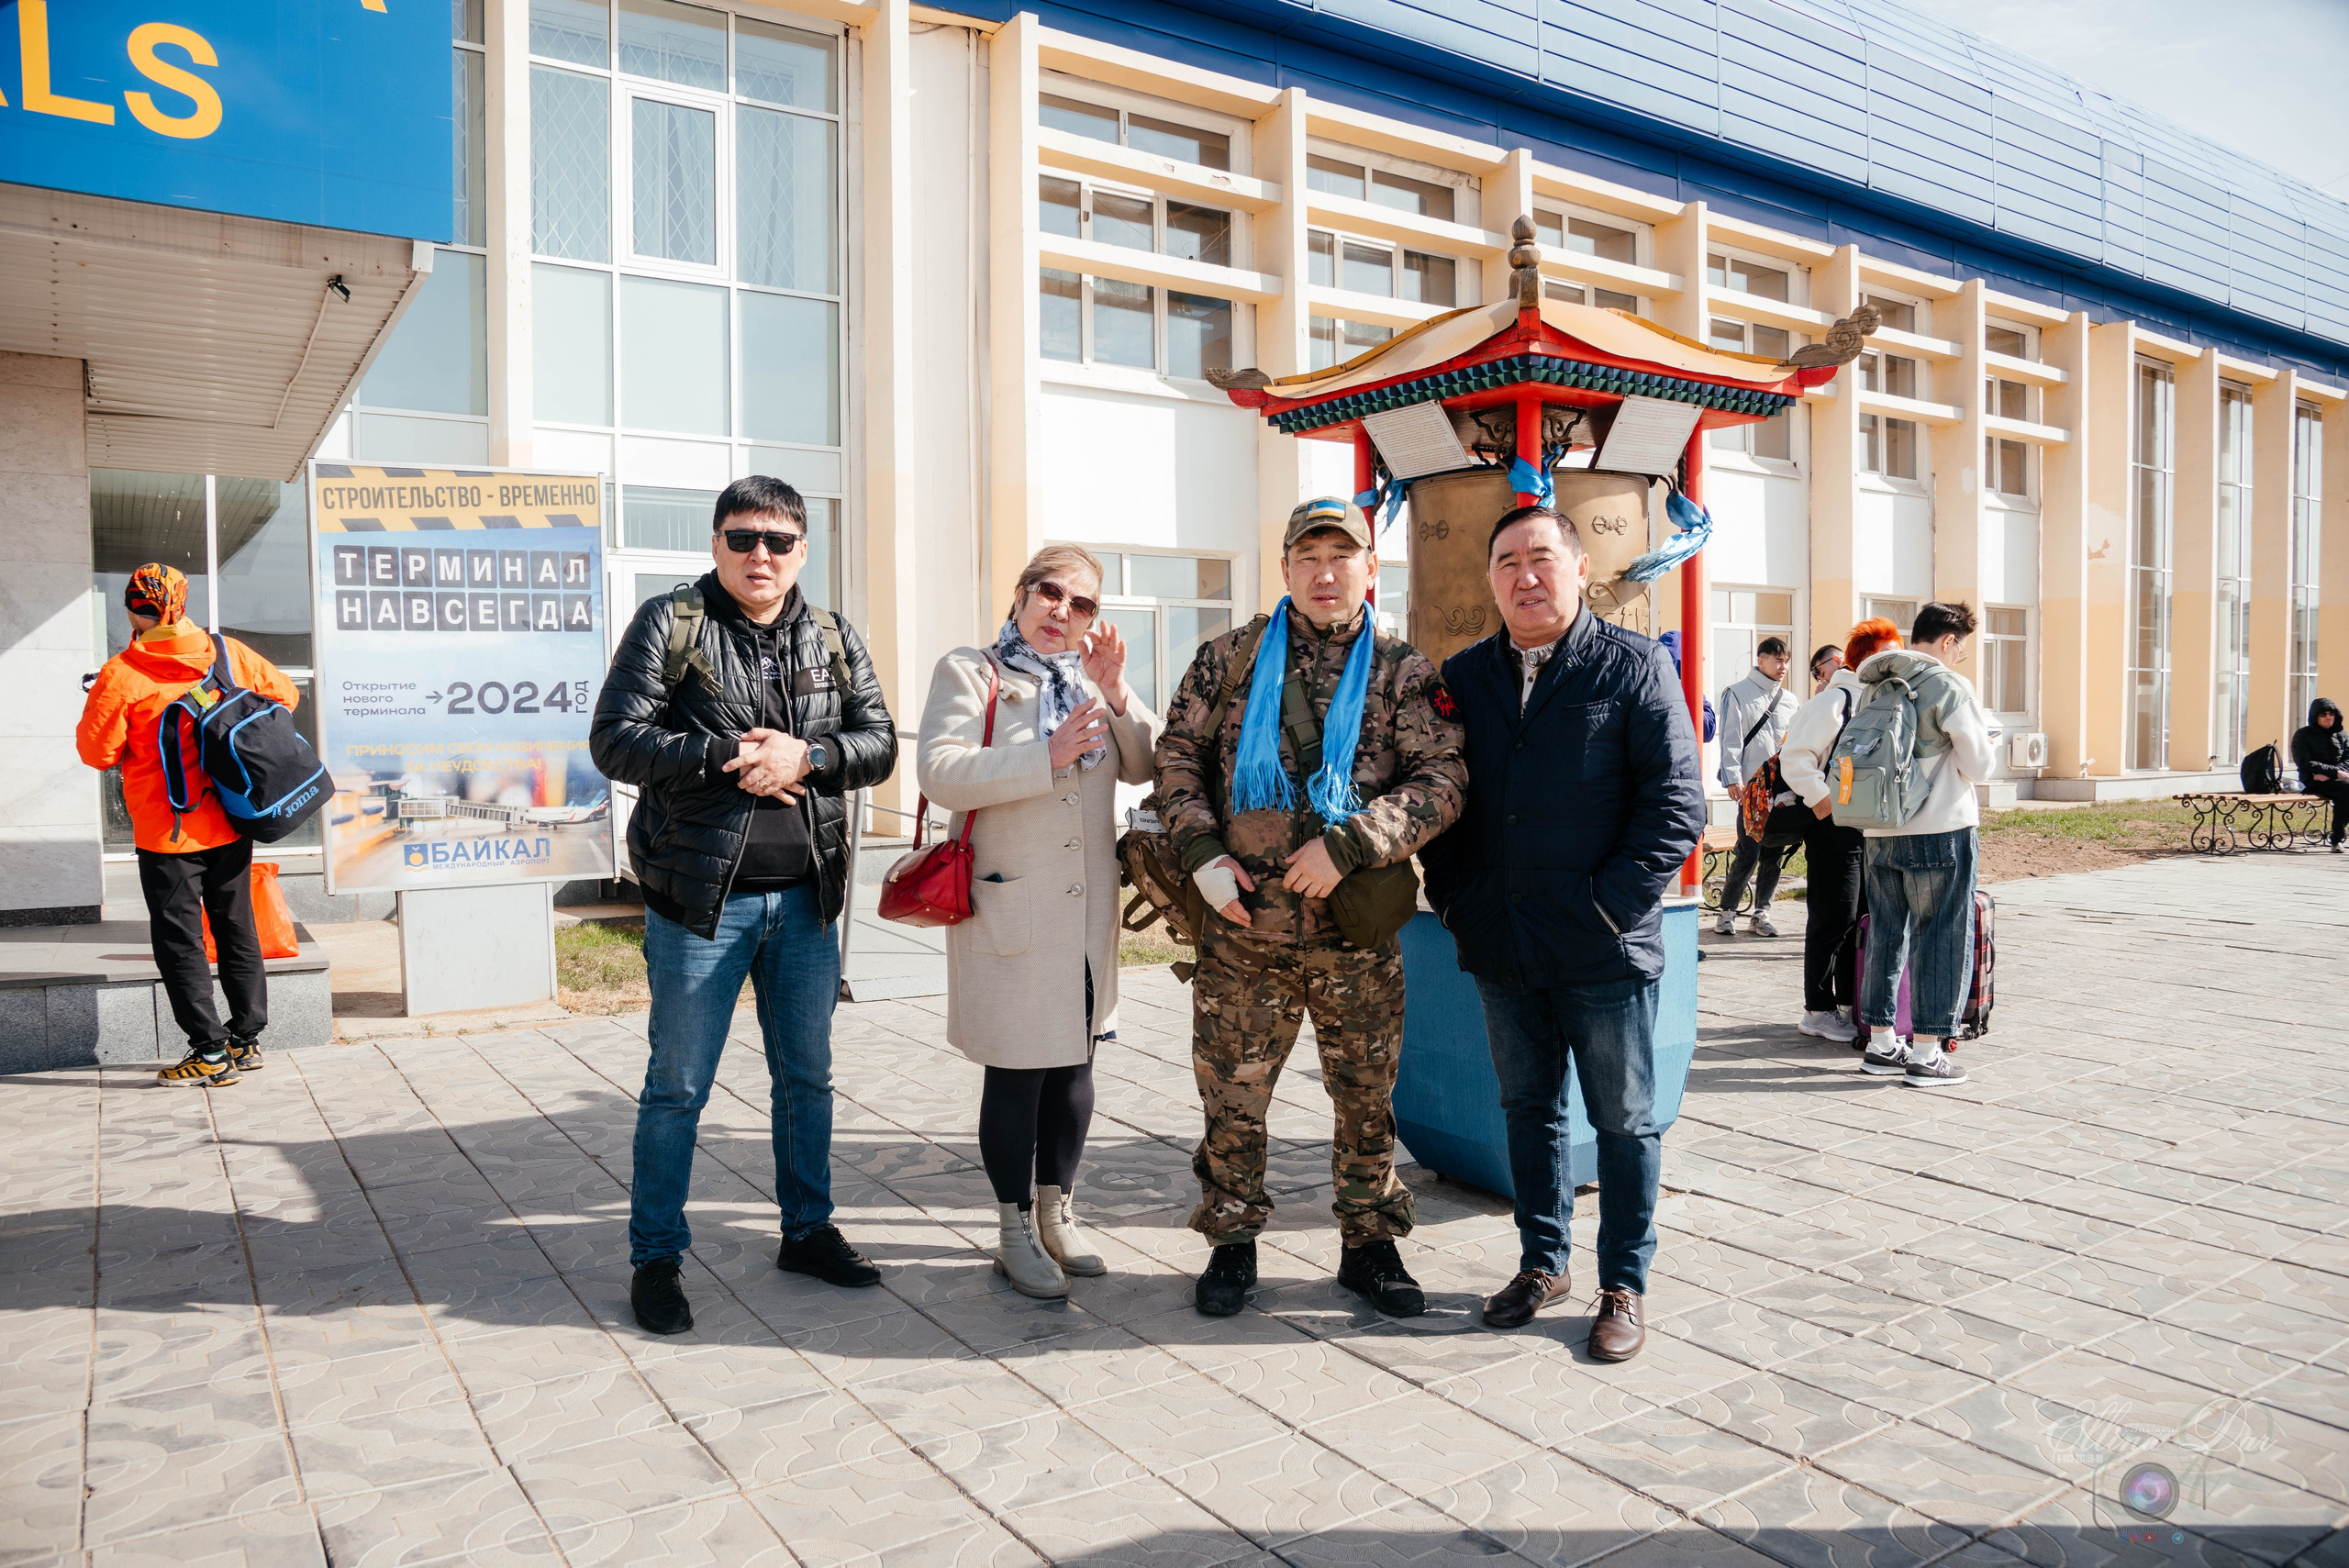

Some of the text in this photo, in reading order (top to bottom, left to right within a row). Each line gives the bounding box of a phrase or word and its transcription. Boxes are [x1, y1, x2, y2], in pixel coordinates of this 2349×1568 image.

[0, 0, 223, 139] LS
[322, 485, 482, 510] СТРОИТЕЛЬСТВО
[499, 484, 596, 507] ВРЕМЕННО
[339, 552, 585, 584] ТЕРМИНАЛ
[342, 596, 590, 630] НАВСЕГДА
[342, 681, 417, 693] Открытие
[343, 695, 394, 704] нового
[446, 681, 573, 715] 2024
[343, 706, 426, 717] терминала
[347, 740, 591, 757] ПРИНОСИМ СВОИ ИЗВИНЕНИЯ
[404, 758, 541, 774] ЗА НЕУДОБСТВА!
[431, 836, 551, 863] БАЙКАЛ
[432, 857, 551, 870] МЕЖДУНАРОДНЫЙ АЭРОПОРТ
